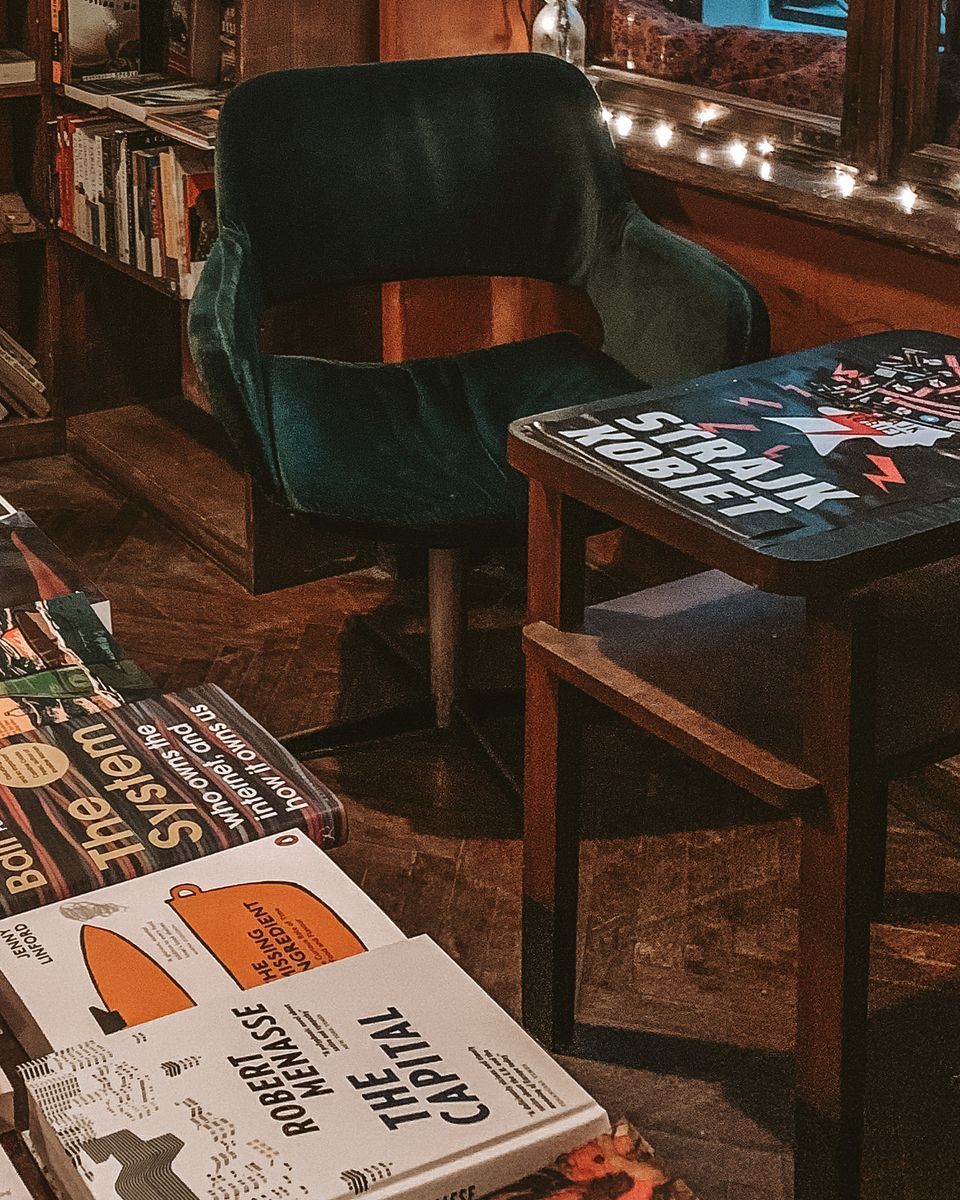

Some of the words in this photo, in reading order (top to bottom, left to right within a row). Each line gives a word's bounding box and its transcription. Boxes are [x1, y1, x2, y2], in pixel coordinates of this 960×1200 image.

[557, 423, 793, 519] KOBIET
[615, 410, 860, 512] STRAJK
[137, 723, 171, 752] the
[168, 723, 212, 756] and
[189, 703, 215, 726] us
[212, 721, 256, 764] owns
[71, 722, 205, 850] System
[158, 741, 209, 793] owns
[206, 751, 275, 823] internet,
[250, 760, 272, 783] it
[267, 774, 309, 813] how
[68, 795, 148, 872] The
[203, 792, 246, 831] who
[14, 922, 54, 966] LINFORD
[231, 1001, 335, 1098] MENASSE
[357, 1005, 492, 1125] CAPITAL
[227, 1053, 321, 1138] ROBERT
[346, 1067, 434, 1131] THE
